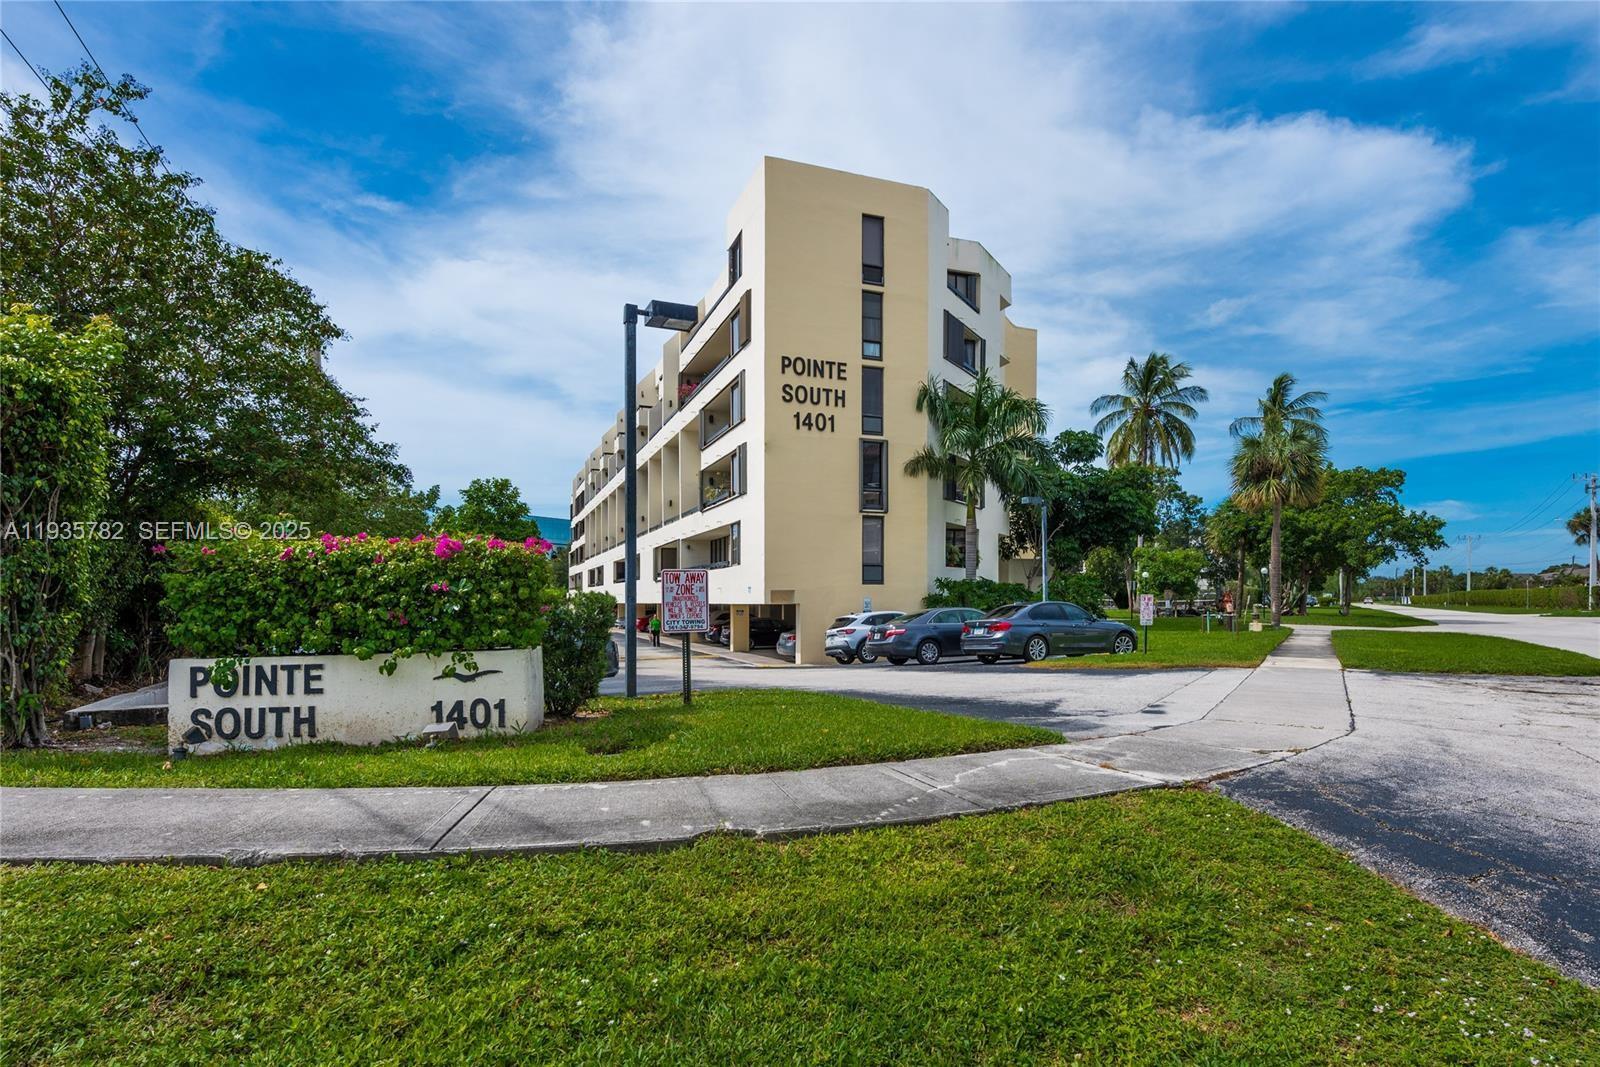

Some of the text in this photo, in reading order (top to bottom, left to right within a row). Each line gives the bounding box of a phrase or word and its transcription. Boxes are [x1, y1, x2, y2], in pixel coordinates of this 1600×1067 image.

[781, 356, 847, 381] POINTE
[782, 384, 846, 408] SOUTH
[793, 411, 835, 433] 1401
[665, 573, 705, 584] TOW AWAY
[676, 584, 695, 595] ZONE
[190, 664, 324, 698] POINTE
[190, 705, 317, 738] SOUTH
[430, 697, 506, 730] 1401
